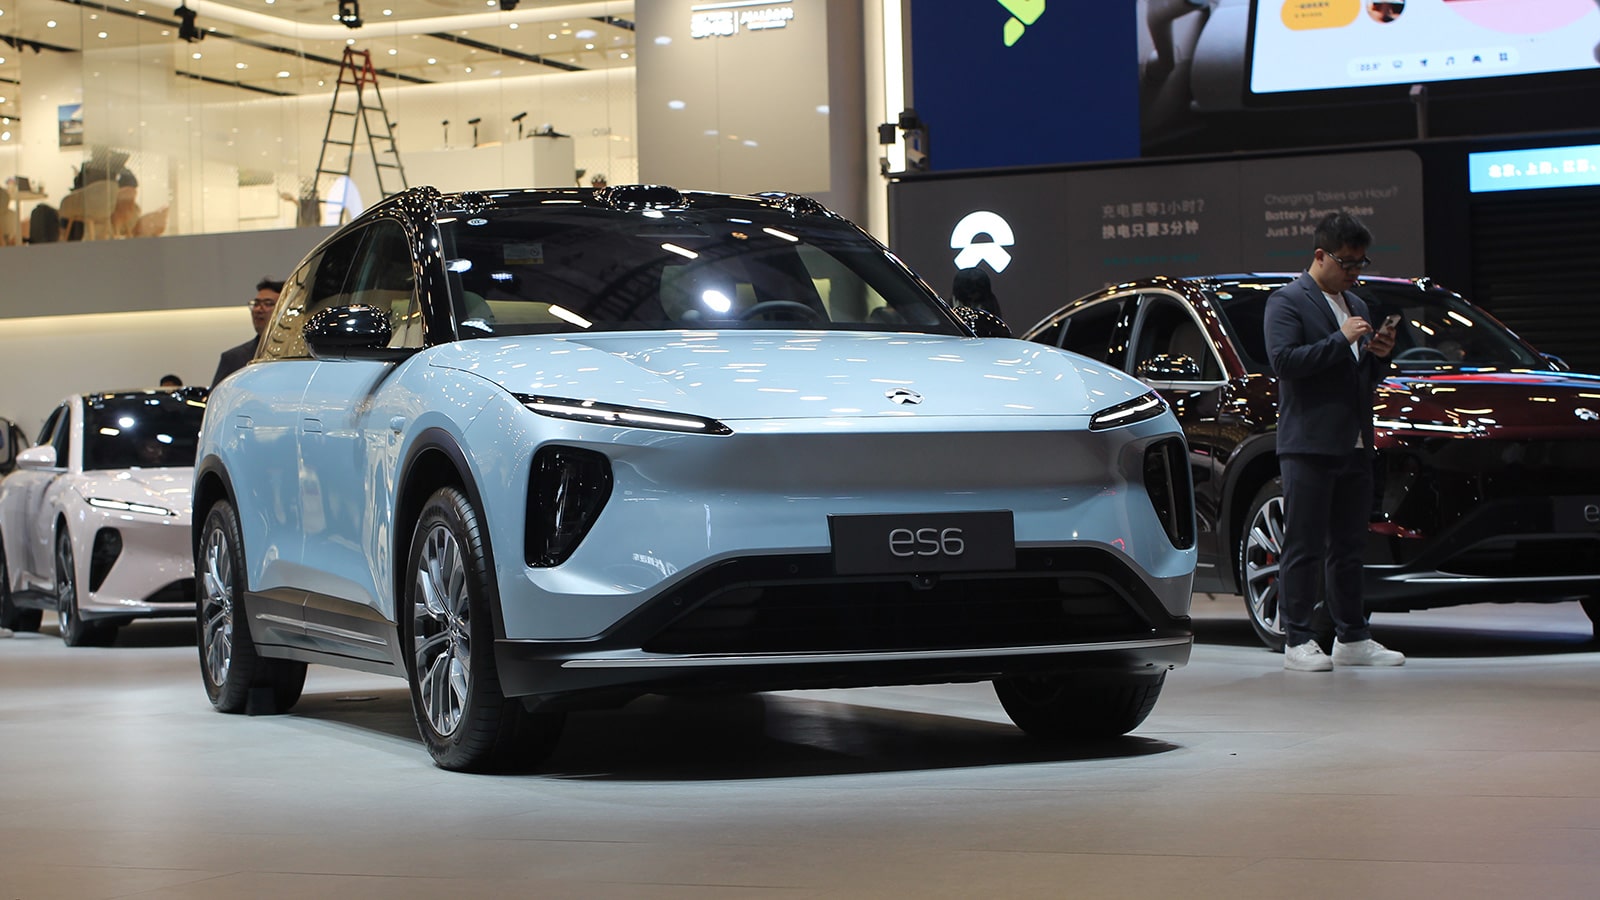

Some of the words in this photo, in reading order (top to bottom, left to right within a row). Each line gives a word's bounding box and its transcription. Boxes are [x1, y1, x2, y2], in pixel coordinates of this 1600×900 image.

[1264, 193, 1314, 206] Charging
[1316, 190, 1346, 202] Takes
[1365, 185, 1398, 200] Hour?
[1264, 209, 1307, 222] Battery
[1102, 220, 1200, 239] 换电只要3分钟
[1265, 225, 1290, 238] Just
[1291, 224, 1299, 236] 3
[888, 527, 965, 557] es6
